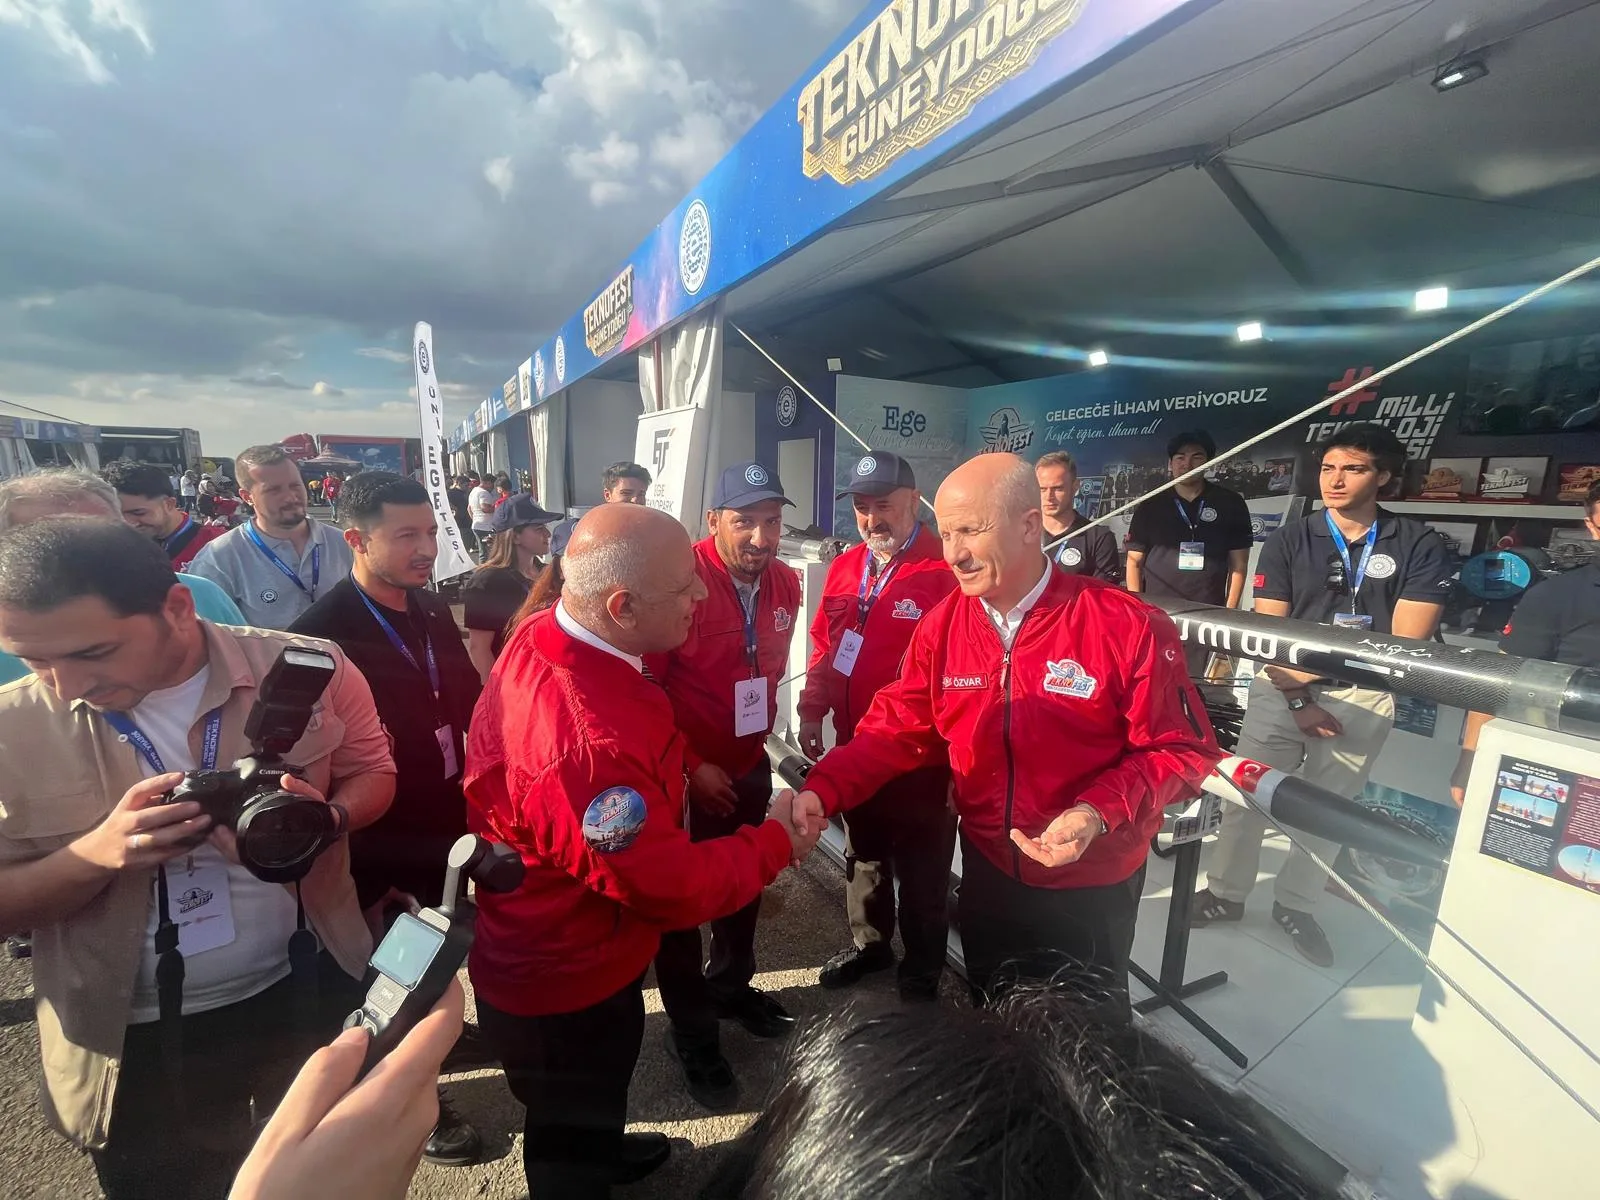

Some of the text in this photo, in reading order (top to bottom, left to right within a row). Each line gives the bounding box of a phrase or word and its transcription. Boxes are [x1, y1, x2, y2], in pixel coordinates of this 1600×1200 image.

[799, 0, 977, 154] TEKNO
[584, 265, 632, 337] TEKNOFEST
[882, 405, 926, 437] Ege
[1046, 387, 1268, 423] GELECEĞE İLHAM VERİYORUZ
[1305, 415, 1445, 443] TELOJİ
[953, 676, 983, 688] ÖZVAR
